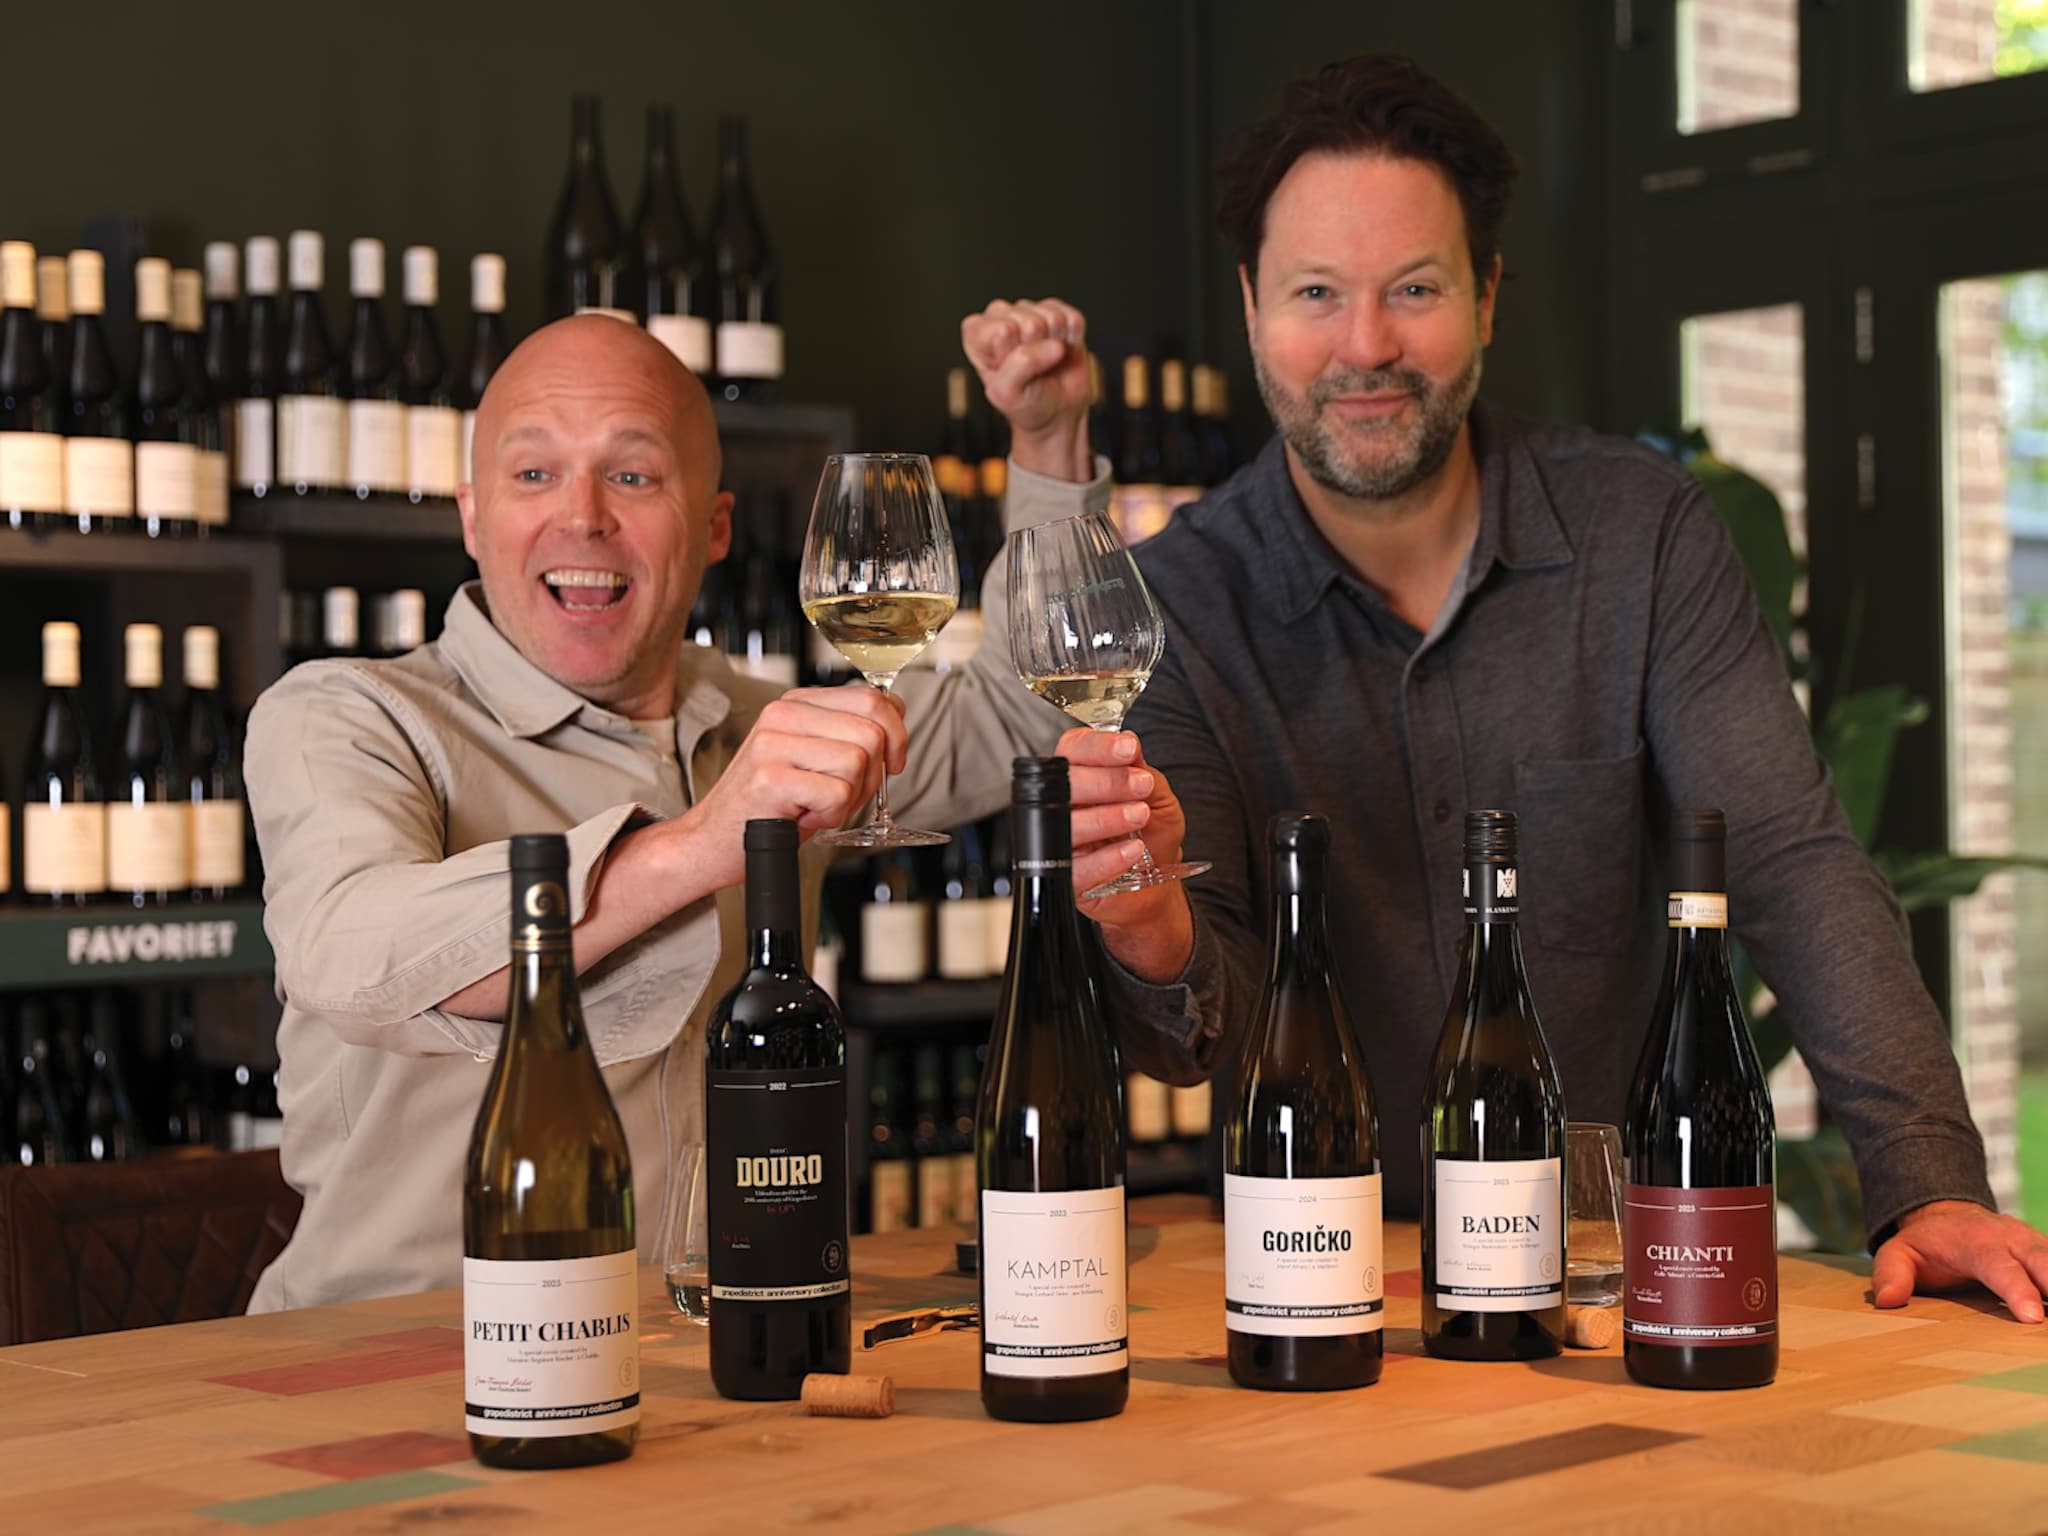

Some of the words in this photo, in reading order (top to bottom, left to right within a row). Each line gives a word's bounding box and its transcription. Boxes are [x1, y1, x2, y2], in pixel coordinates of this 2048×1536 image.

[67, 920, 238, 965] FAVORIET
[735, 1154, 823, 1187] DOURO
[1298, 1195, 1317, 1204] 2024
[1049, 1209, 1067, 1218] 2023
[1461, 1214, 1541, 1234] BADEN
[1263, 1224, 1352, 1253] GORIČKO
[1646, 1244, 1734, 1262] CHIANTI
[1007, 1257, 1109, 1280] KAMPTAL
[766, 1287, 812, 1297] anniversary
[1289, 1306, 1339, 1317] anniversary
[473, 1320, 533, 1343] PETIT
[537, 1313, 631, 1343] CHABLIS
[1671, 1325, 1720, 1338] anniversary
[1720, 1325, 1757, 1337] collection
[1043, 1345, 1091, 1356] anniversary
[483, 1407, 534, 1419] grapedistrict
[535, 1406, 588, 1419] anniversary
